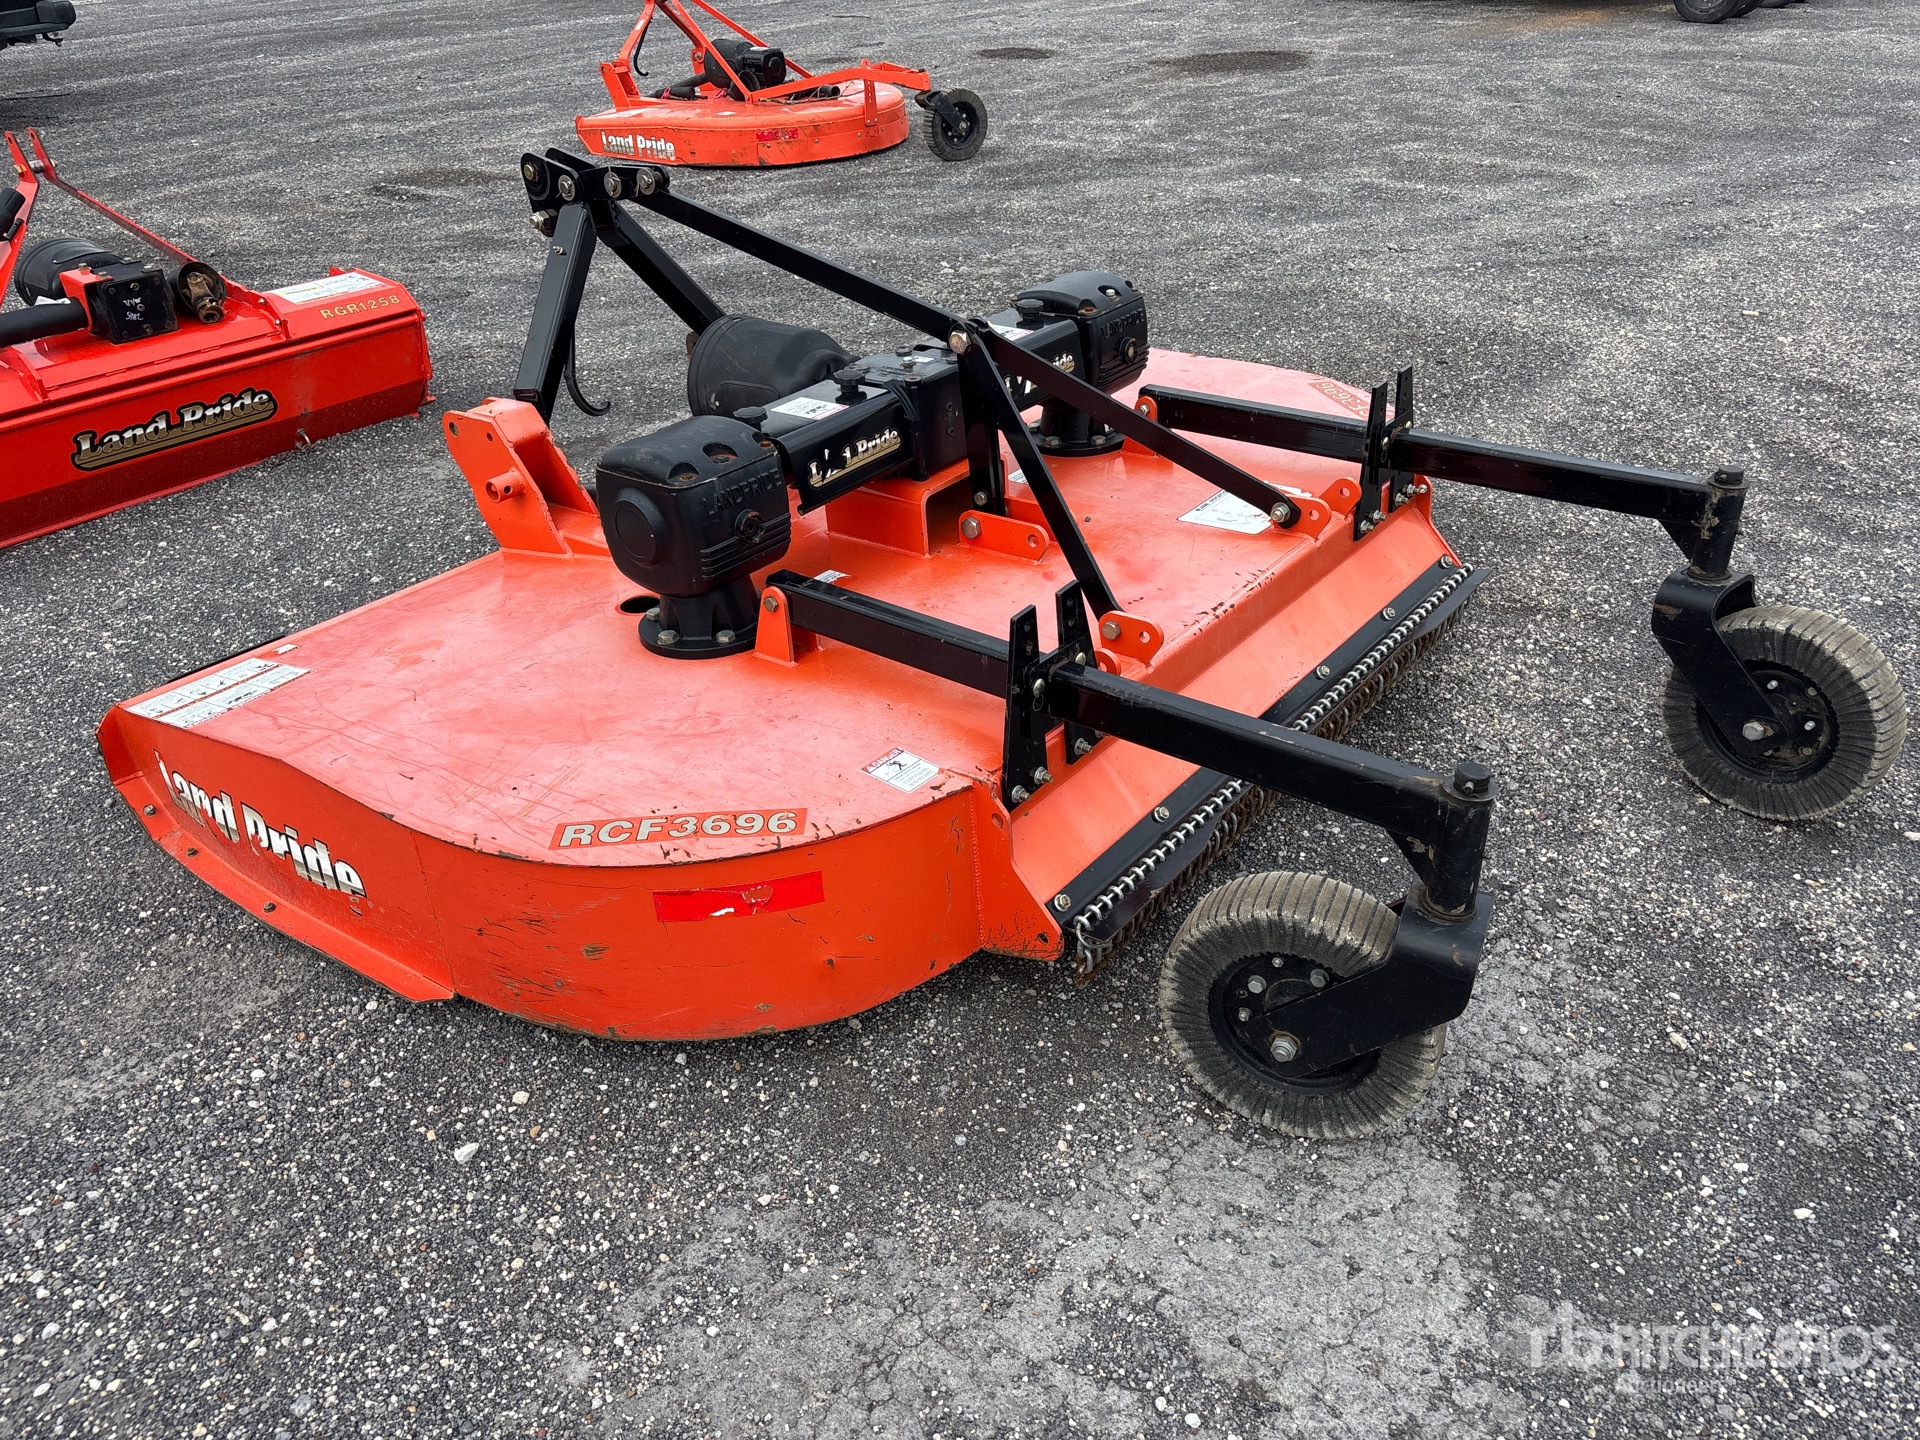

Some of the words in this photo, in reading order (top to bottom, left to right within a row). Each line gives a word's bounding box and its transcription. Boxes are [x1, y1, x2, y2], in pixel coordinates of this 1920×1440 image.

[601, 130, 634, 156] Land
[636, 134, 676, 161] Pride
[320, 295, 400, 319] RGR1258
[1052, 353, 1075, 372] ide
[1315, 382, 1372, 417] CF3696
[76, 413, 170, 461] Land
[180, 391, 273, 432] Pride
[856, 428, 898, 460] Pride
[703, 467, 782, 516] LANDPRIDE
[558, 812, 797, 847] RCF3696
[241, 801, 367, 898] Pride
